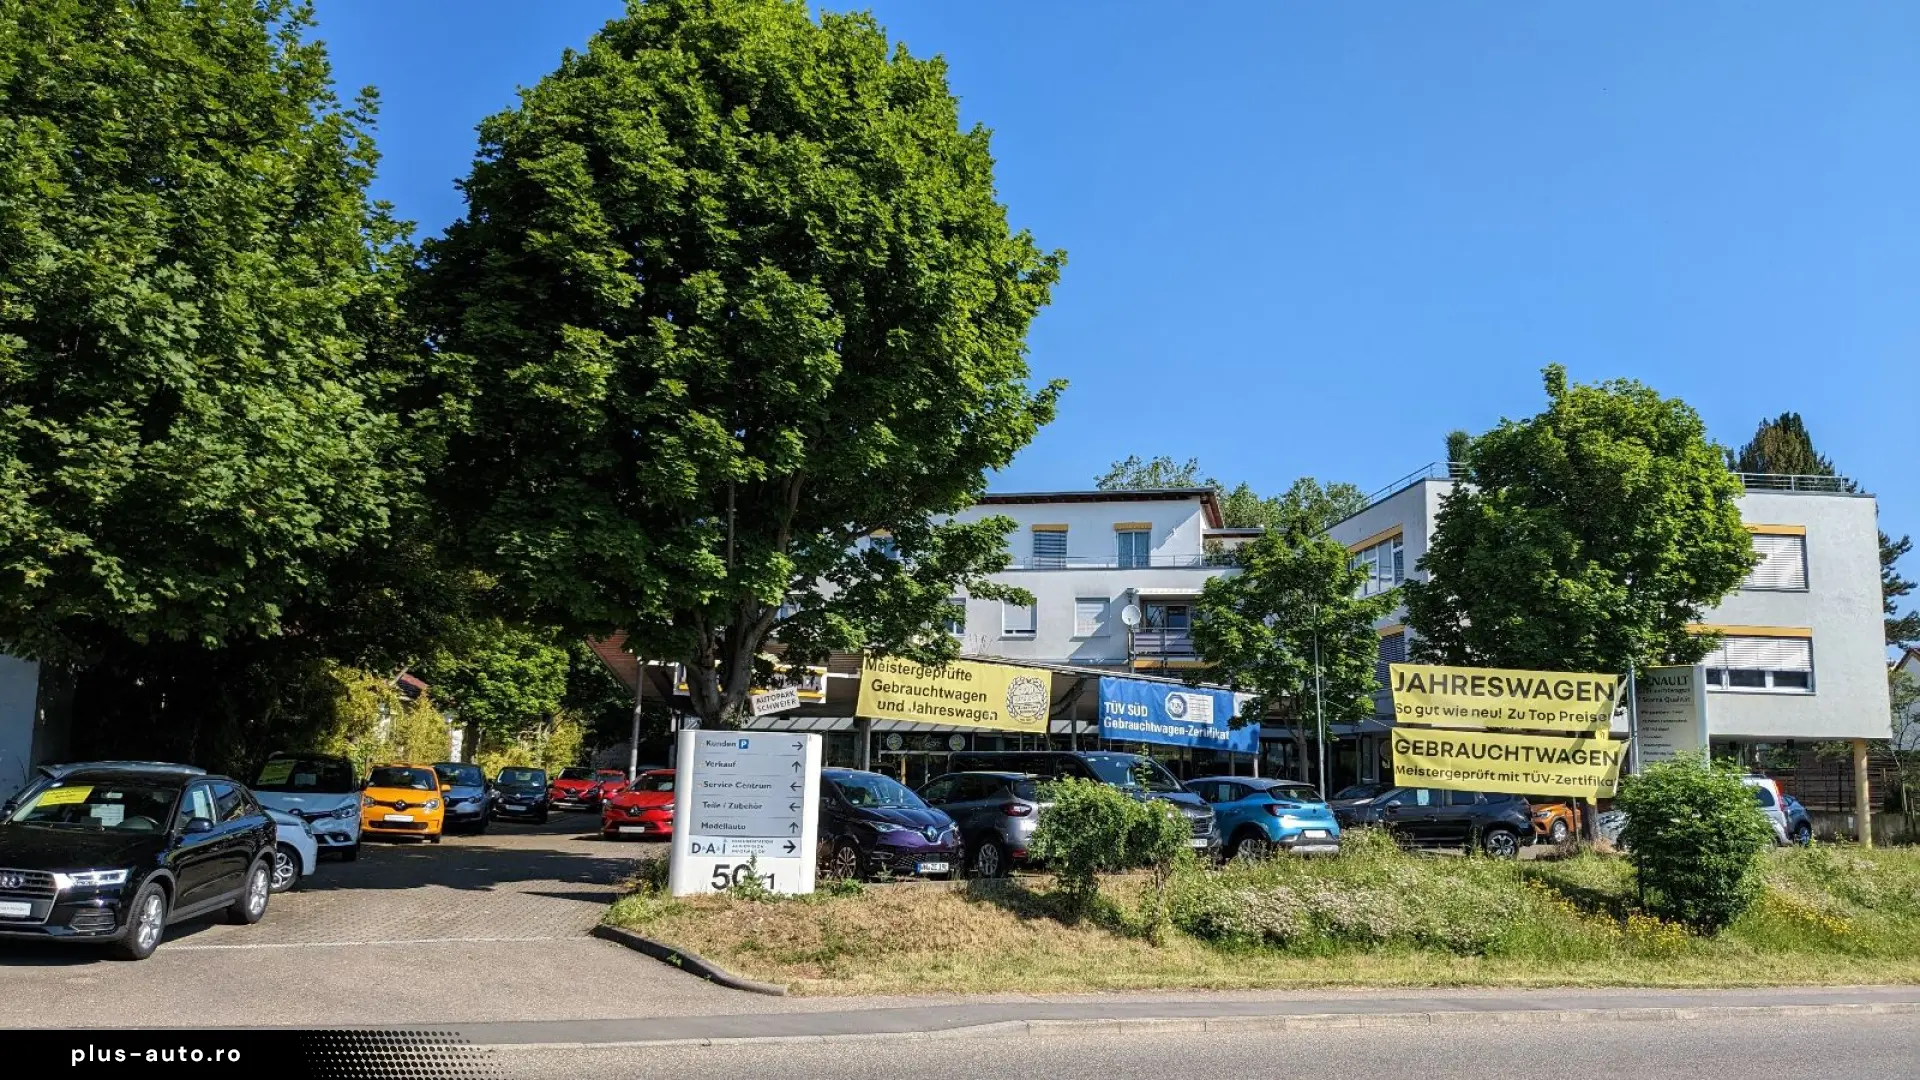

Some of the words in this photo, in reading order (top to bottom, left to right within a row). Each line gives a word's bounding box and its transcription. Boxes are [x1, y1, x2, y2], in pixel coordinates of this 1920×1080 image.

[865, 659, 972, 681] Meistergeprüfte
[757, 690, 795, 703] AUTOPARK
[871, 678, 987, 703] Gebrauchtwagen
[1394, 672, 1614, 702] JAHRESWAGEN
[757, 700, 796, 712] SCHWEIER
[877, 700, 905, 712] und
[908, 701, 998, 722] Jahreswagen
[1104, 699, 1126, 714] TÜV
[1127, 702, 1148, 717] SÜD
[1396, 703, 1412, 714] So
[1415, 705, 1440, 718] gut
[1443, 705, 1468, 717] wie
[1471, 707, 1502, 719] neu!
[1508, 708, 1525, 720] Zu
[1529, 709, 1556, 724] Top
[1103, 716, 1230, 740] Gebrauchtwagen-Zertifikat
[1394, 739, 1619, 766] GEBRAUCHTWAGEN
[705, 760, 737, 768] Verkauf
[703, 780, 733, 788] Service
[735, 781, 772, 789] Centrum
[1395, 765, 1495, 781] Meistergeprüft
[1498, 771, 1520, 782] mit
[1523, 770, 1616, 787] TÜV-Zertifika
[702, 801, 721, 809] Teile
[728, 801, 763, 810] Zubehör
[701, 822, 746, 830] Modellauto
